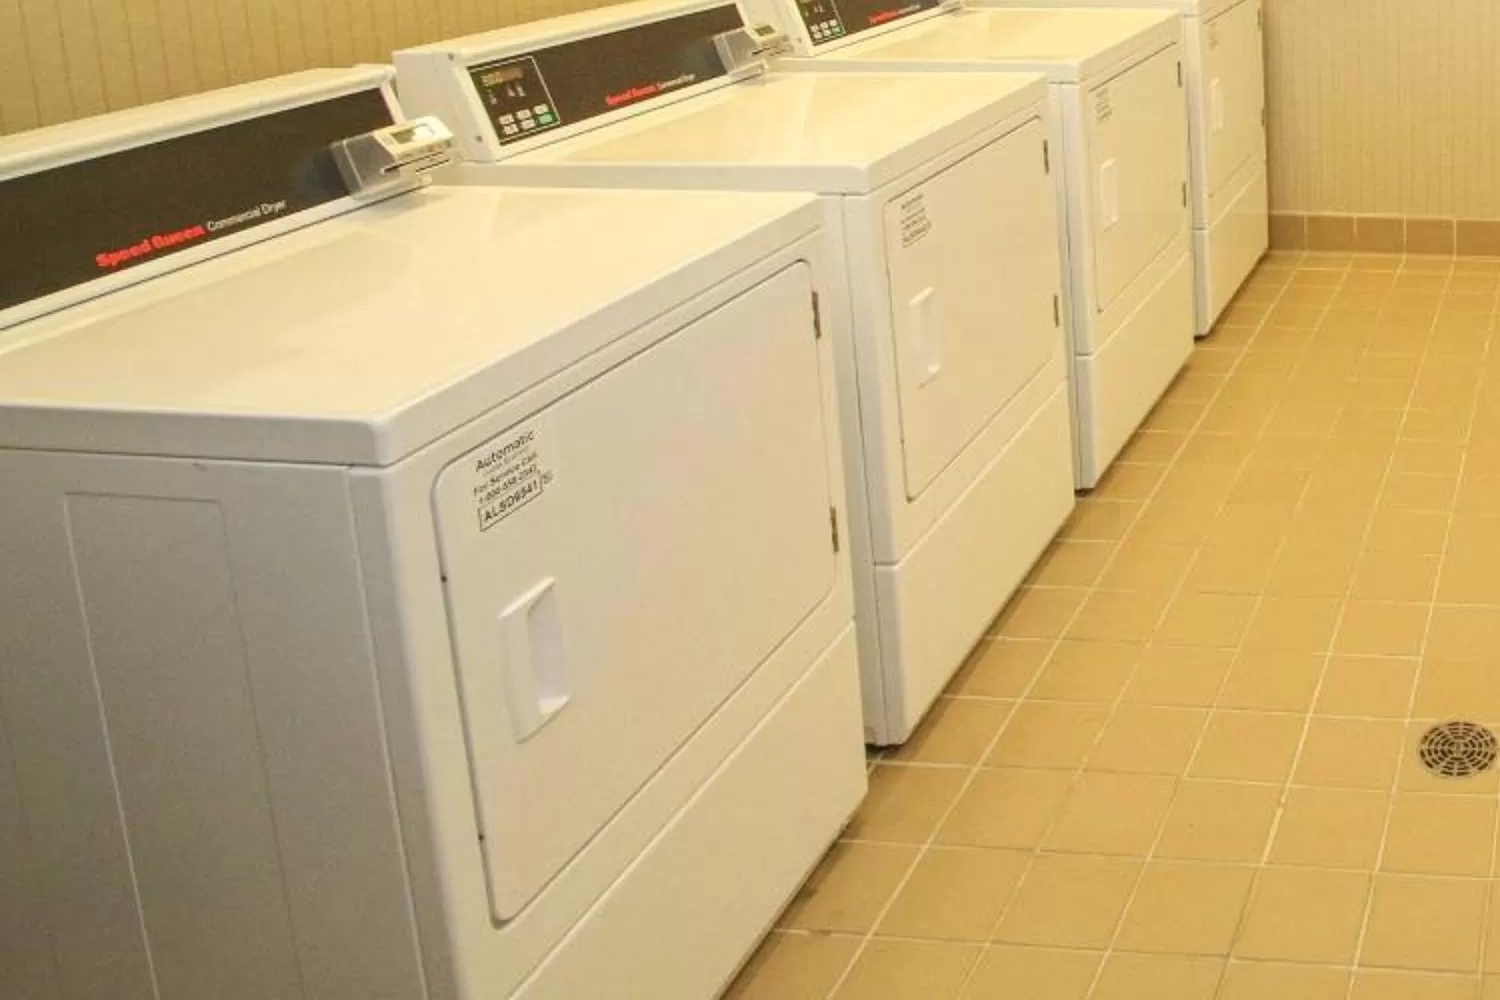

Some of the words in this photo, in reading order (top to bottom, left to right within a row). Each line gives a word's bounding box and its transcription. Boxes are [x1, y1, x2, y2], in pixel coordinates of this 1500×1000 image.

[96, 240, 150, 267] Speed
[151, 225, 206, 249] Queen
[206, 206, 261, 232] Commercial
[261, 200, 288, 217] Dryer
[476, 430, 535, 473] Automatic
